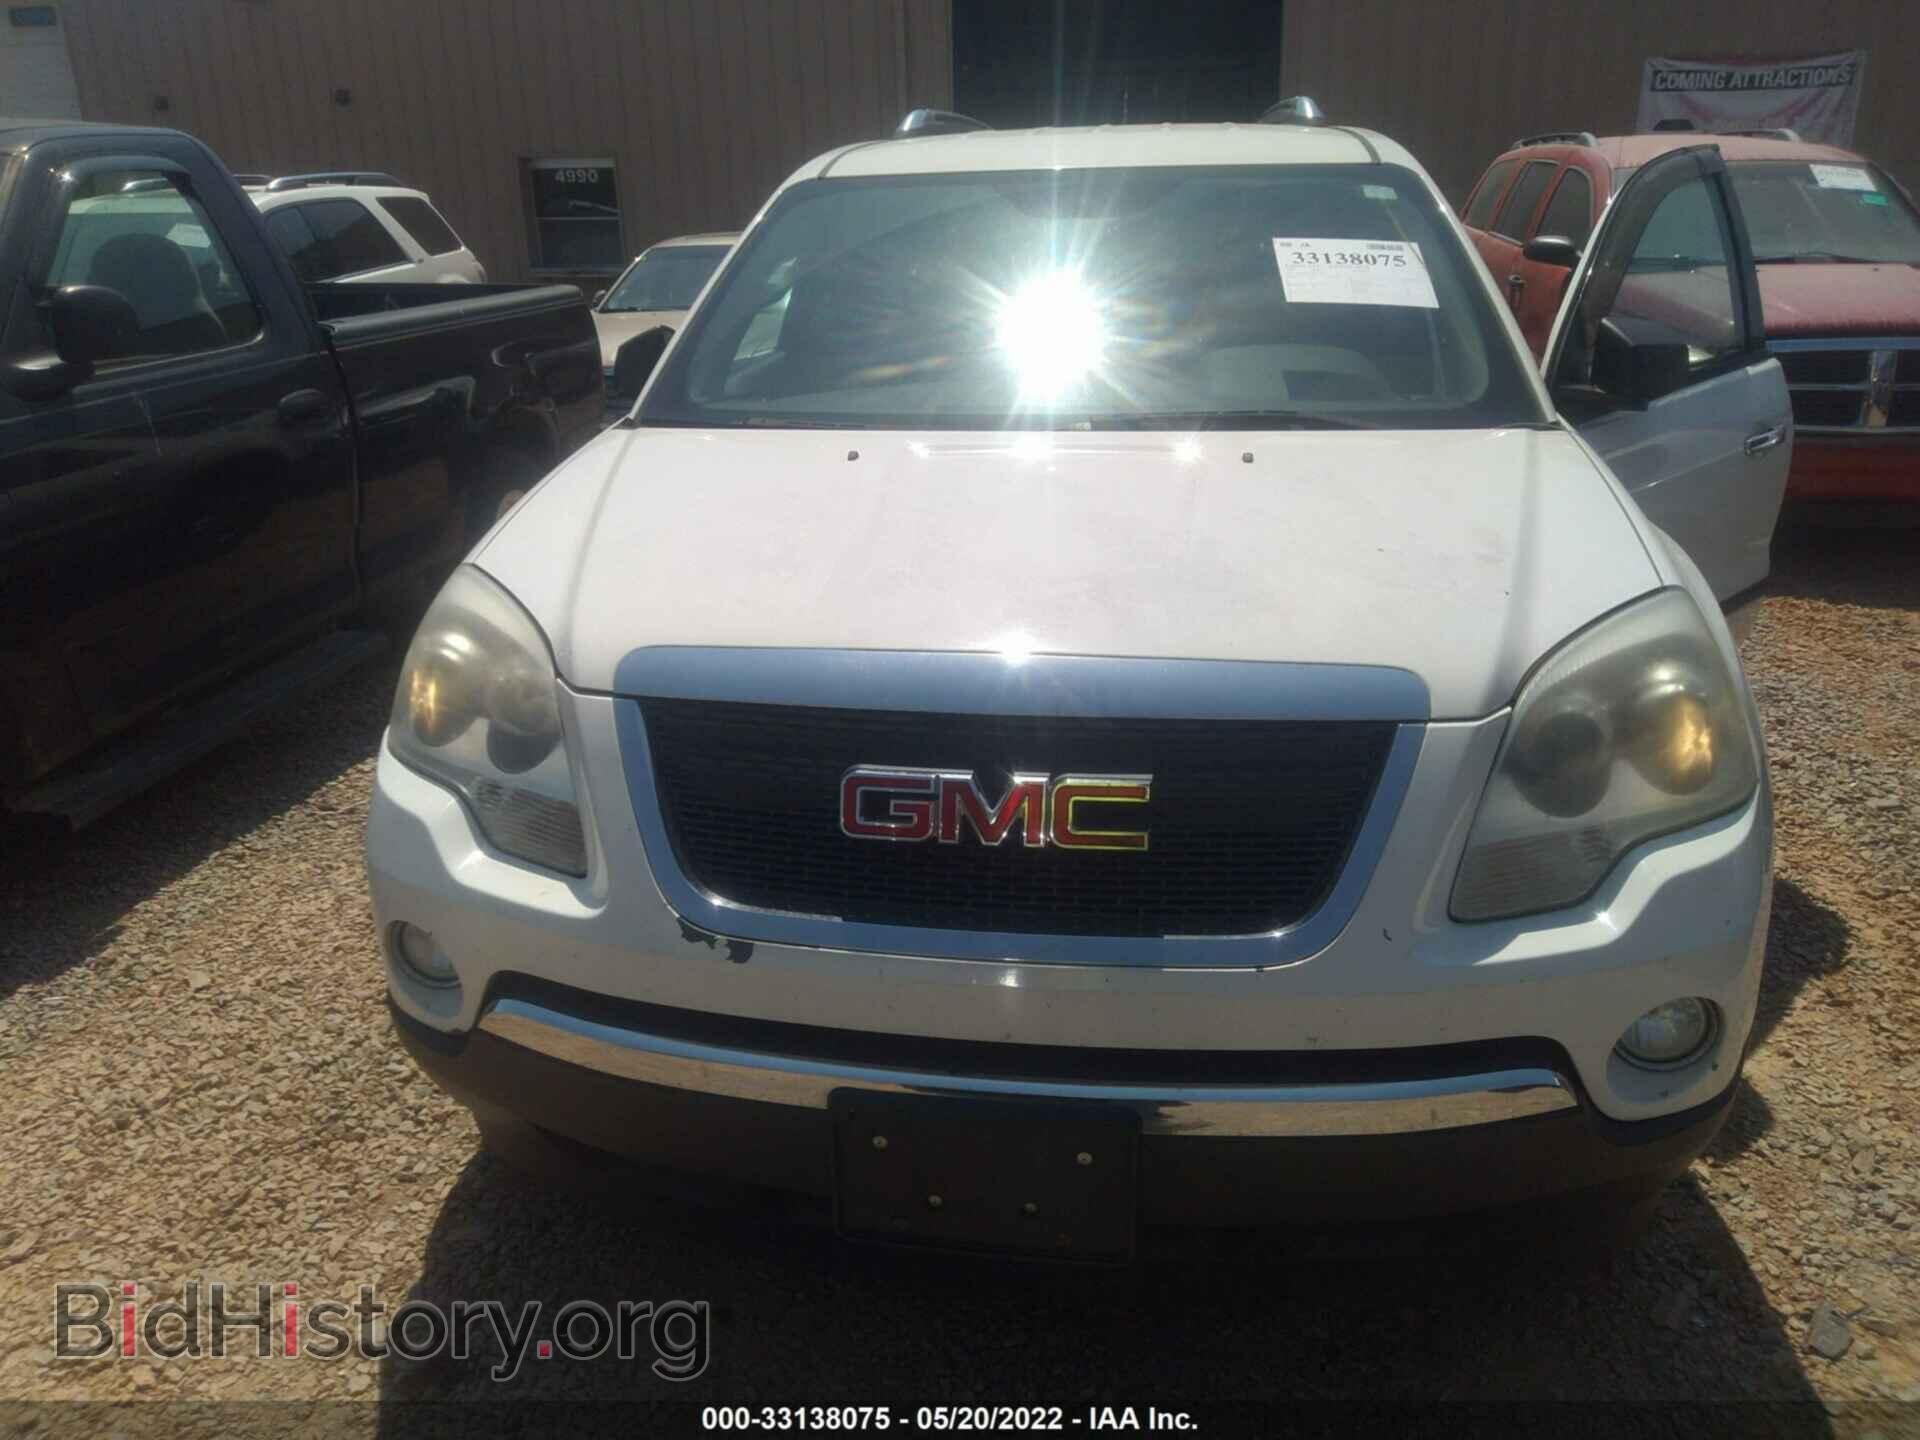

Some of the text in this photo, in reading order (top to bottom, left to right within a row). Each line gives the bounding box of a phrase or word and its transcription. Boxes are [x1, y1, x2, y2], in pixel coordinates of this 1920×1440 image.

[1655, 64, 1851, 90] COMING ATTRACTIONS
[555, 169, 599, 183] 4990
[1292, 252, 1407, 268] 33138075
[840, 764, 1154, 850] GMC
